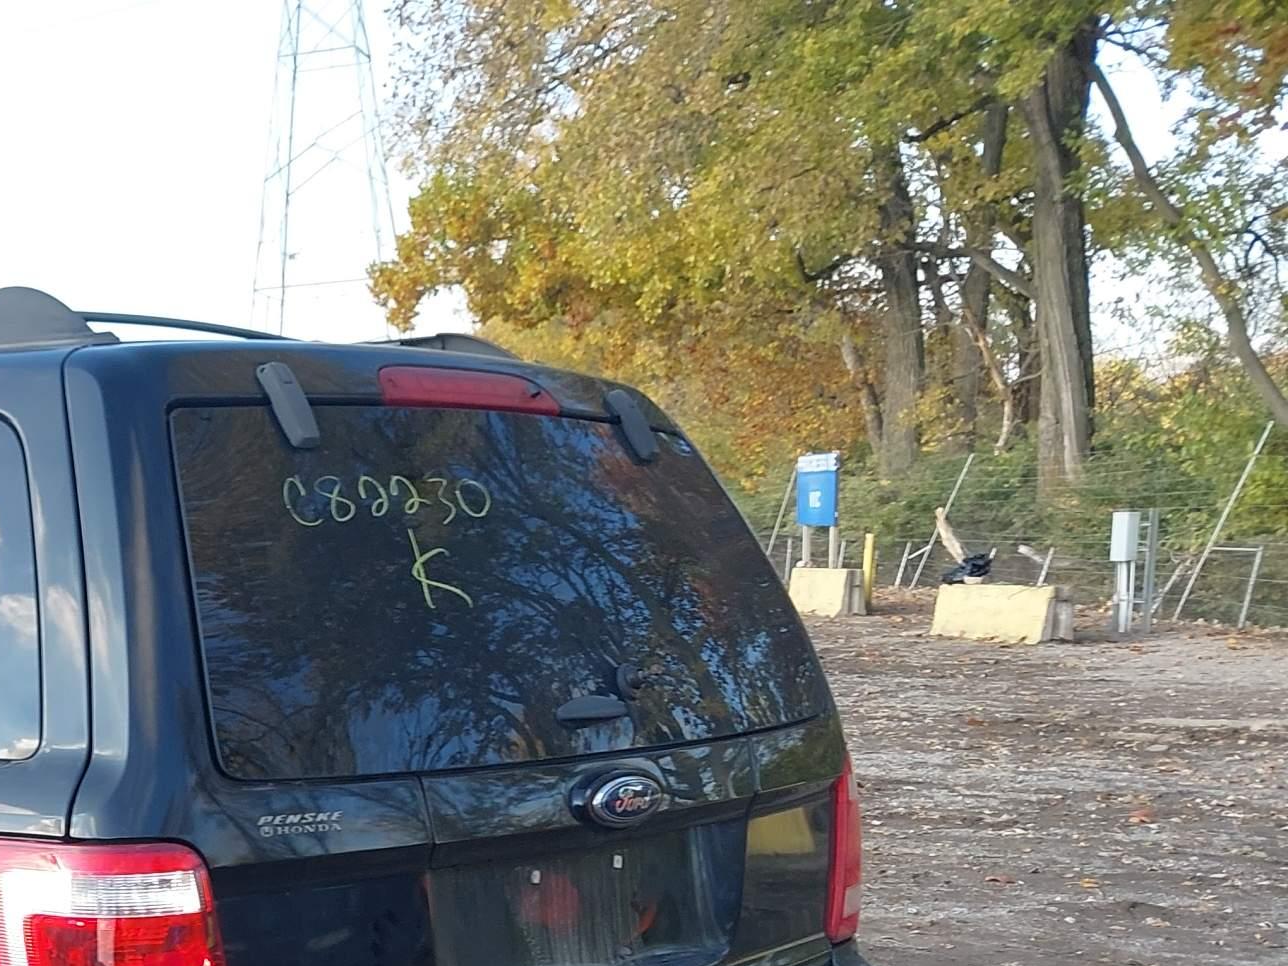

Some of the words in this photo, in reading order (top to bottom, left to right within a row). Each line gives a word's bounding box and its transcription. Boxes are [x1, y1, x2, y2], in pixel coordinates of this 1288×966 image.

[283, 474, 492, 526] C82230
[407, 527, 474, 609] K
[257, 810, 345, 826] PENSKE
[277, 823, 343, 835] HONDA
